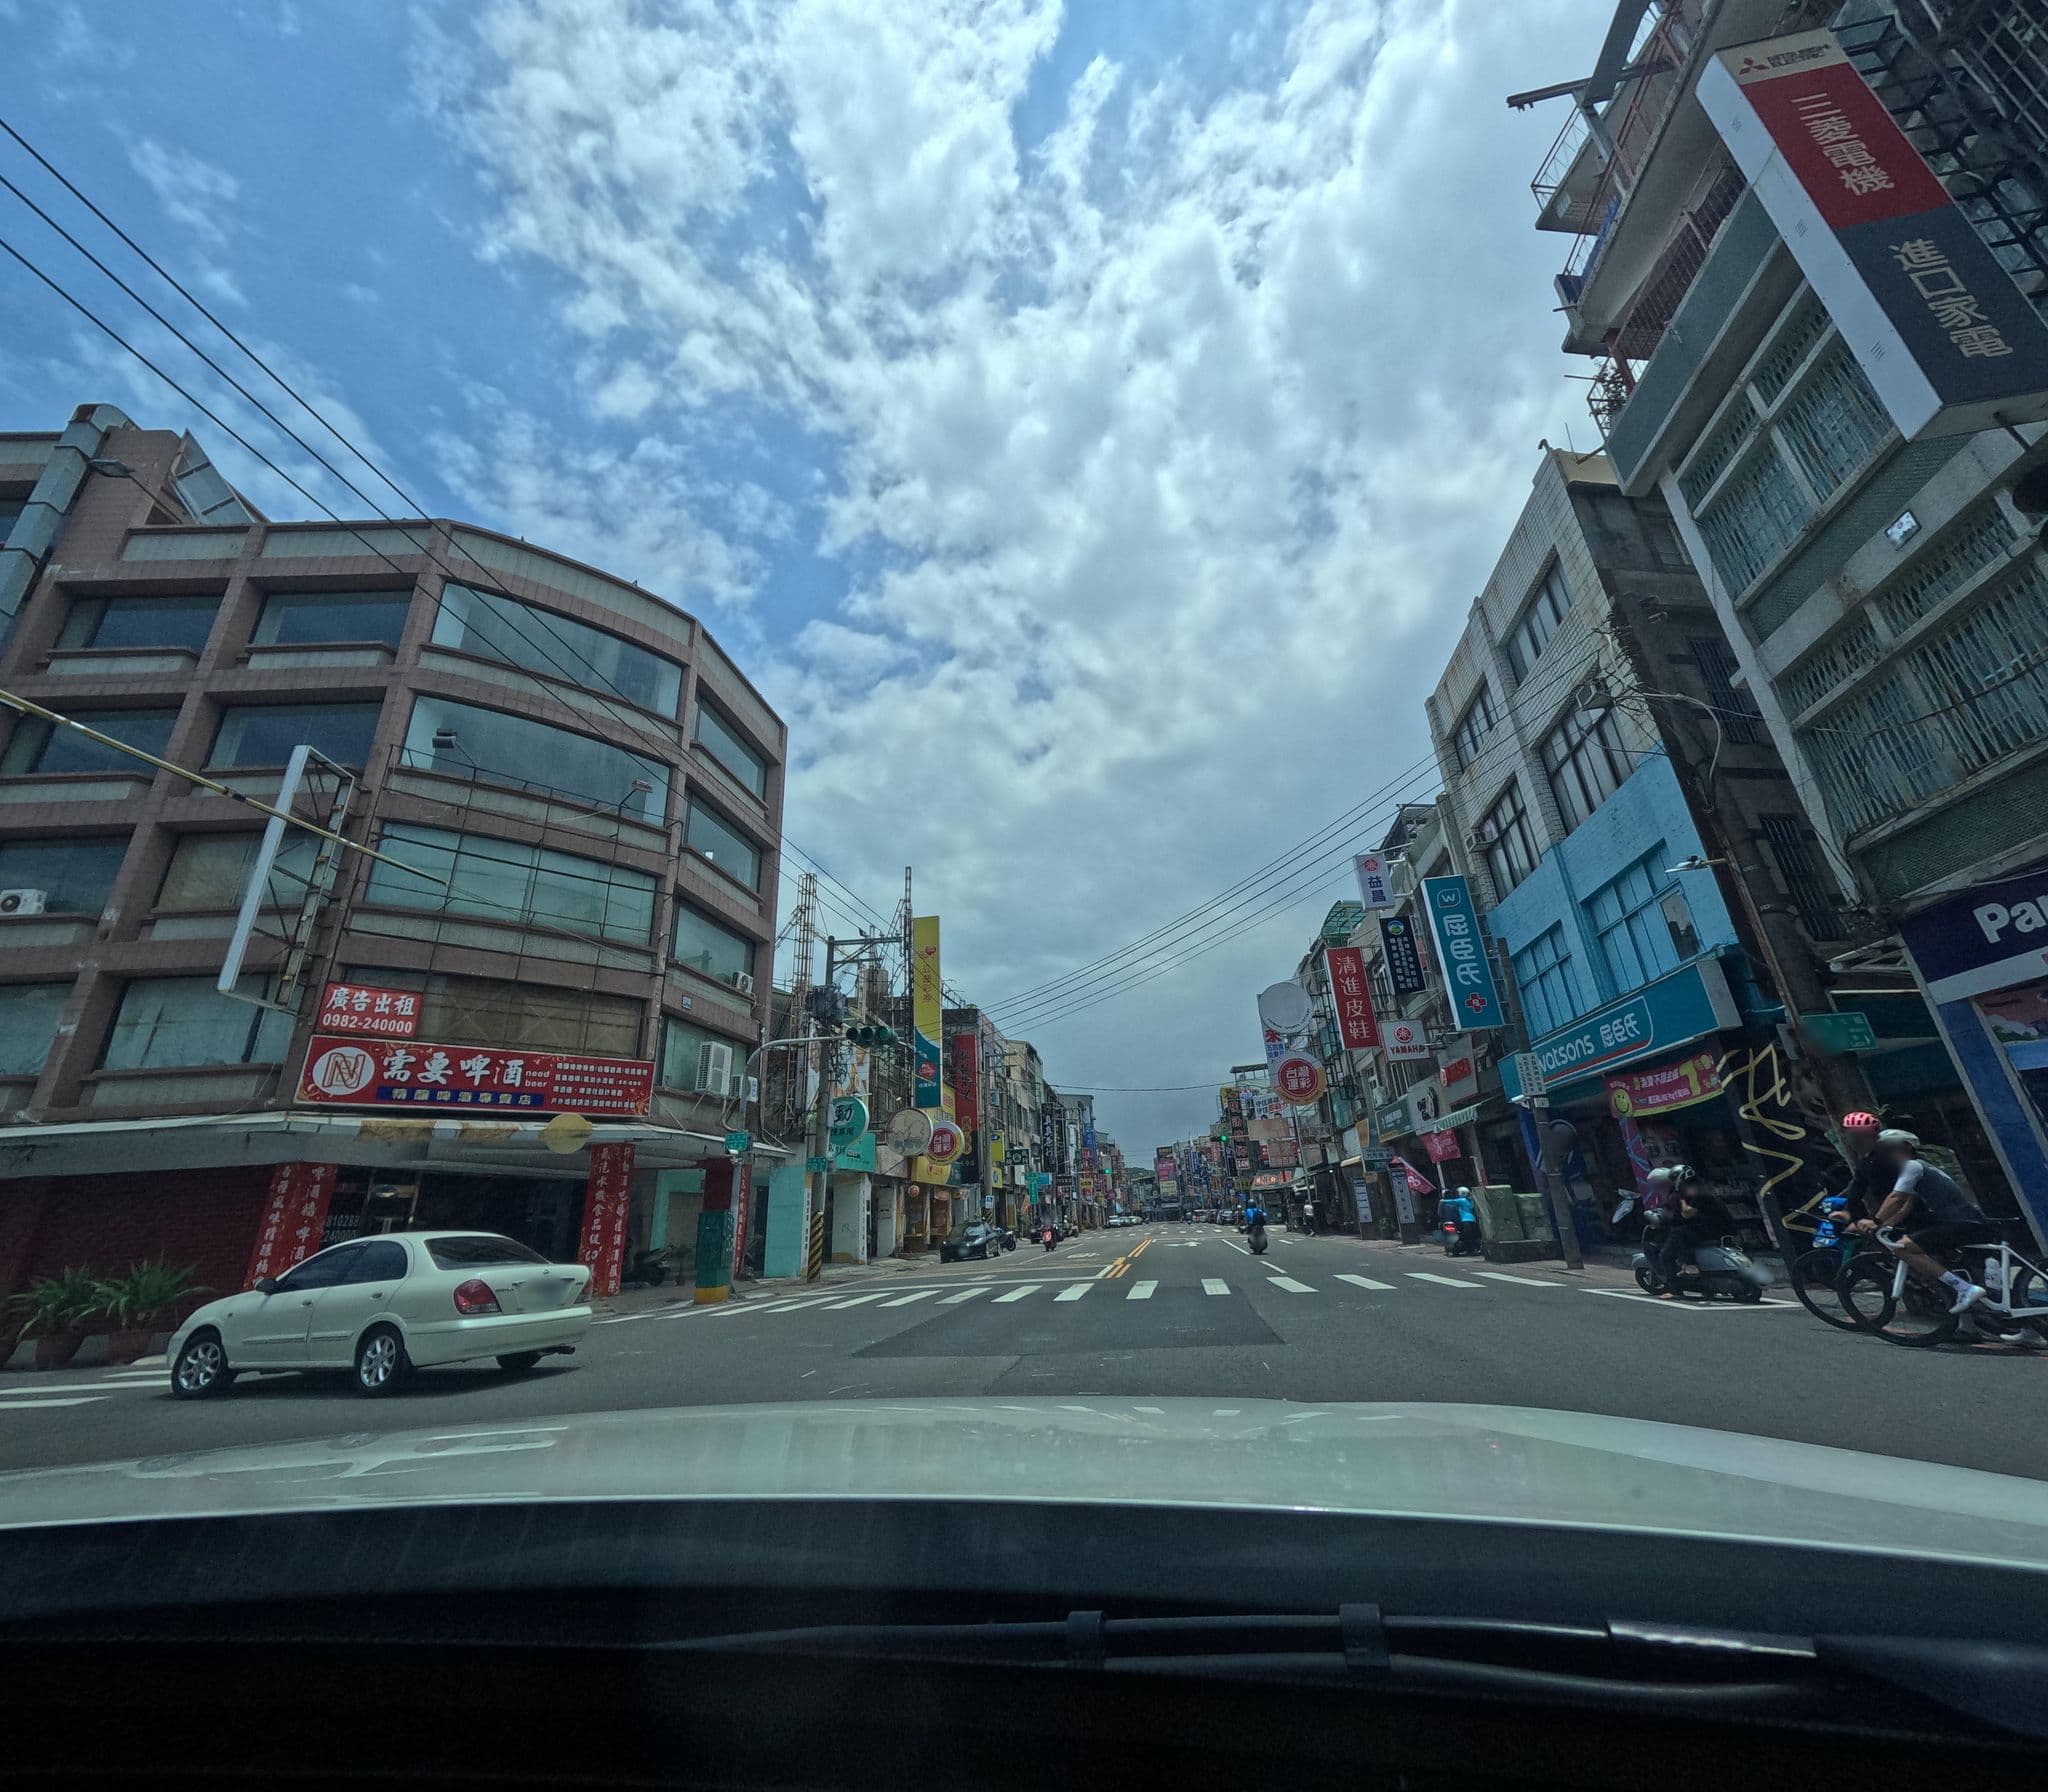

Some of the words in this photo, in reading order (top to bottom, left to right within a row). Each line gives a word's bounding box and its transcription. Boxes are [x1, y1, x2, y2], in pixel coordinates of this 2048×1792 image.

[1791, 92, 1895, 196] 三菱電機
[1887, 238, 2014, 359] 進口家電
[1367, 875, 1387, 903] 益昌
[1972, 895, 2048, 944] Pa
[1442, 913, 1483, 986] 屈臣氏
[325, 986, 415, 1016] 廣告出租
[1336, 955, 1372, 1040] 清進皮鞋
[322, 1013, 413, 1034] 0982-240000
[1599, 1012, 1641, 1048] 屈臣氏
[382, 1048, 525, 1087] 需要啤酒
[524, 1079, 548, 1088] beer
[525, 1069, 550, 1078] need
